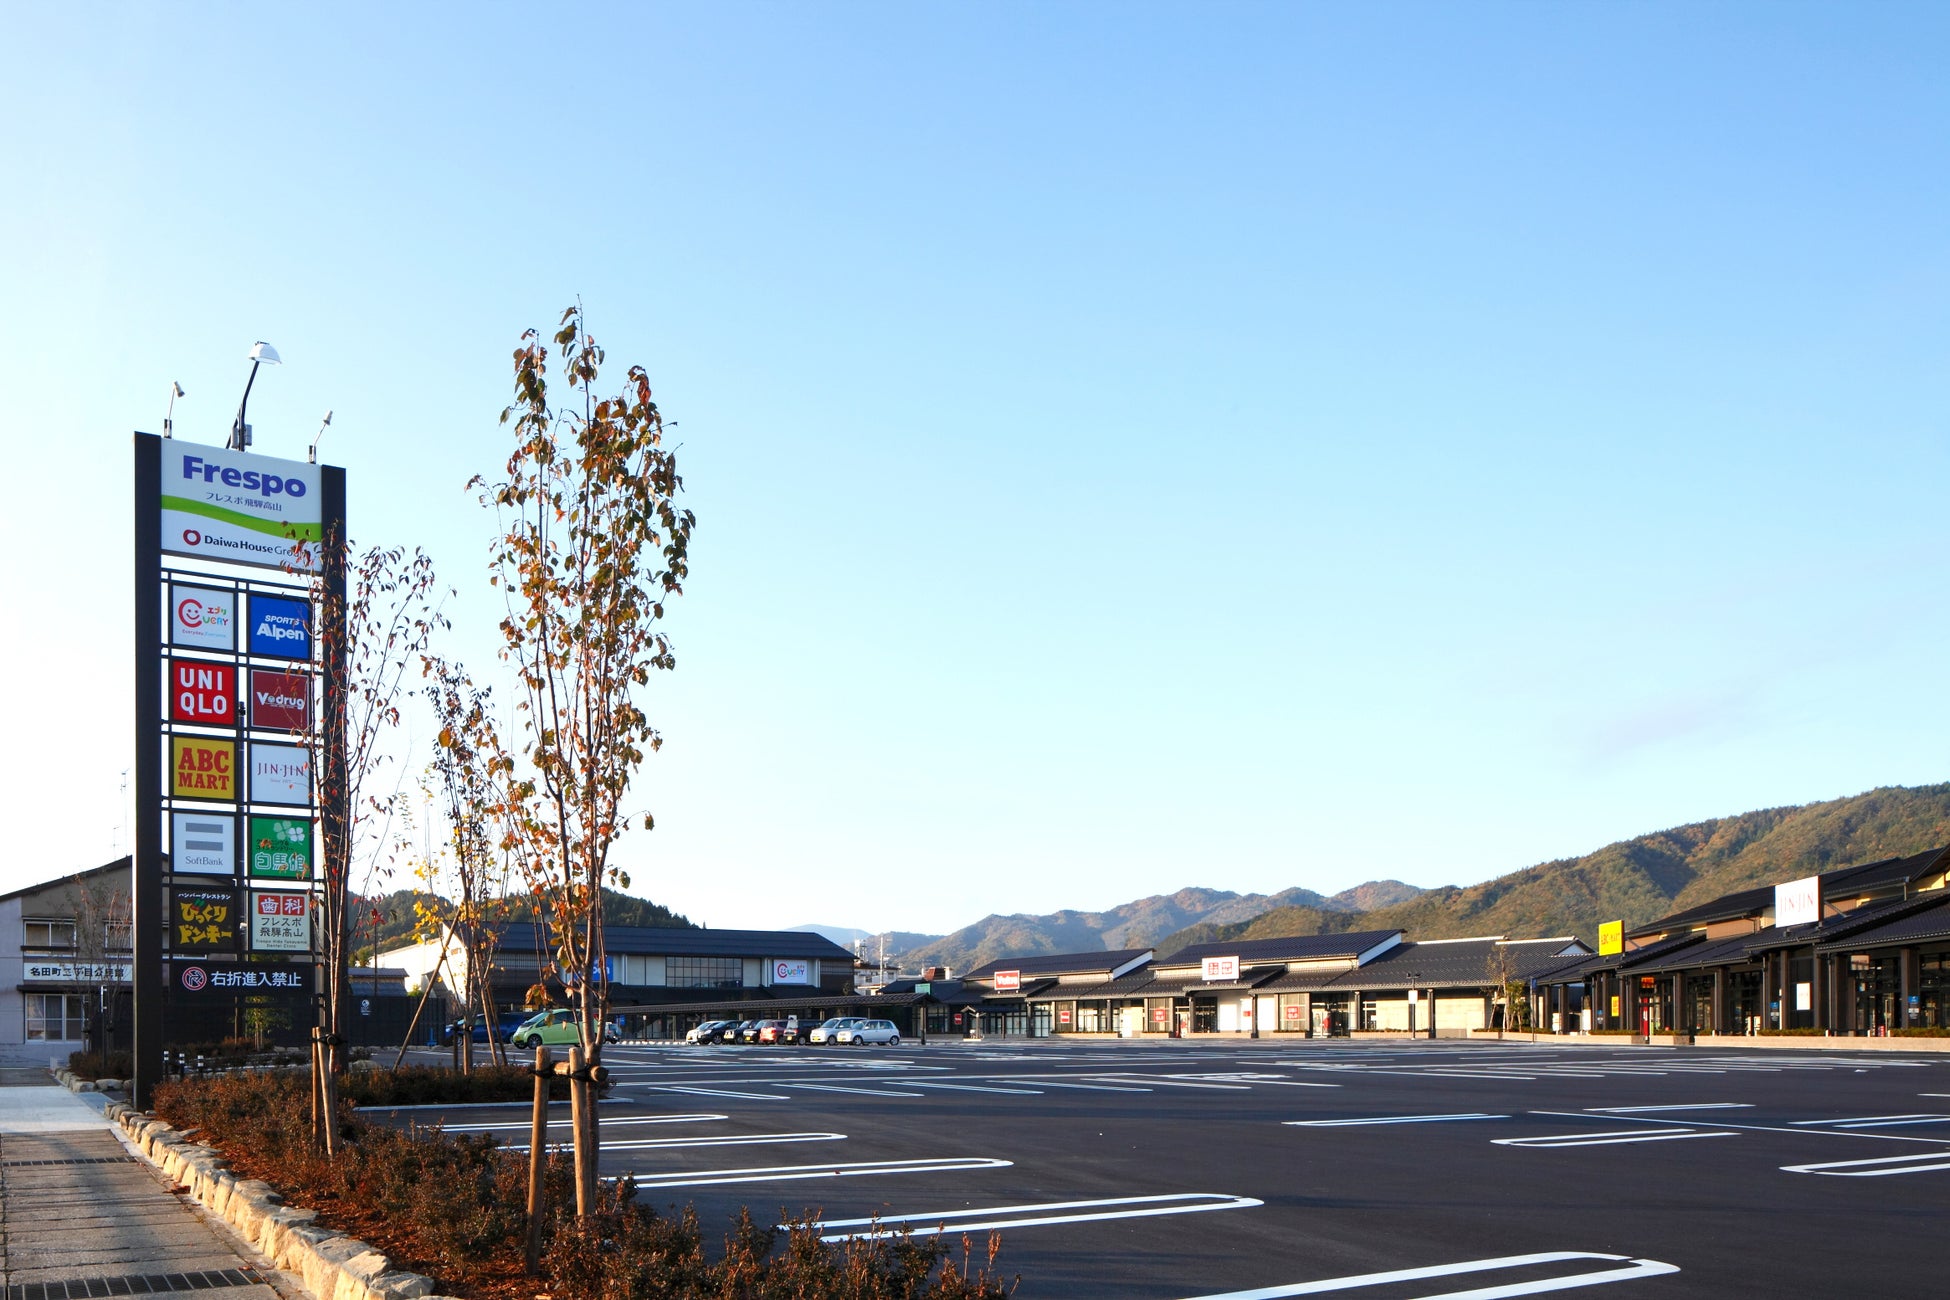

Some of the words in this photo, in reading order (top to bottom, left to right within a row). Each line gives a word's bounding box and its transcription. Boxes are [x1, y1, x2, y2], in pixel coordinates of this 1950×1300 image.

[183, 455, 306, 498] Frespo
[204, 535, 239, 548] Daiwa
[240, 540, 274, 554] House
[256, 622, 305, 640] Alpen
[180, 667, 223, 691] UNI
[180, 692, 227, 716] QLO
[178, 747, 229, 774] ABC
[178, 772, 229, 790] MART
[185, 856, 223, 866] SoftBank
[260, 896, 303, 915] 歯科
[261, 917, 302, 927] フレスポ
[178, 924, 232, 945] ドンキー
[211, 971, 303, 987] 右折進入禁止
